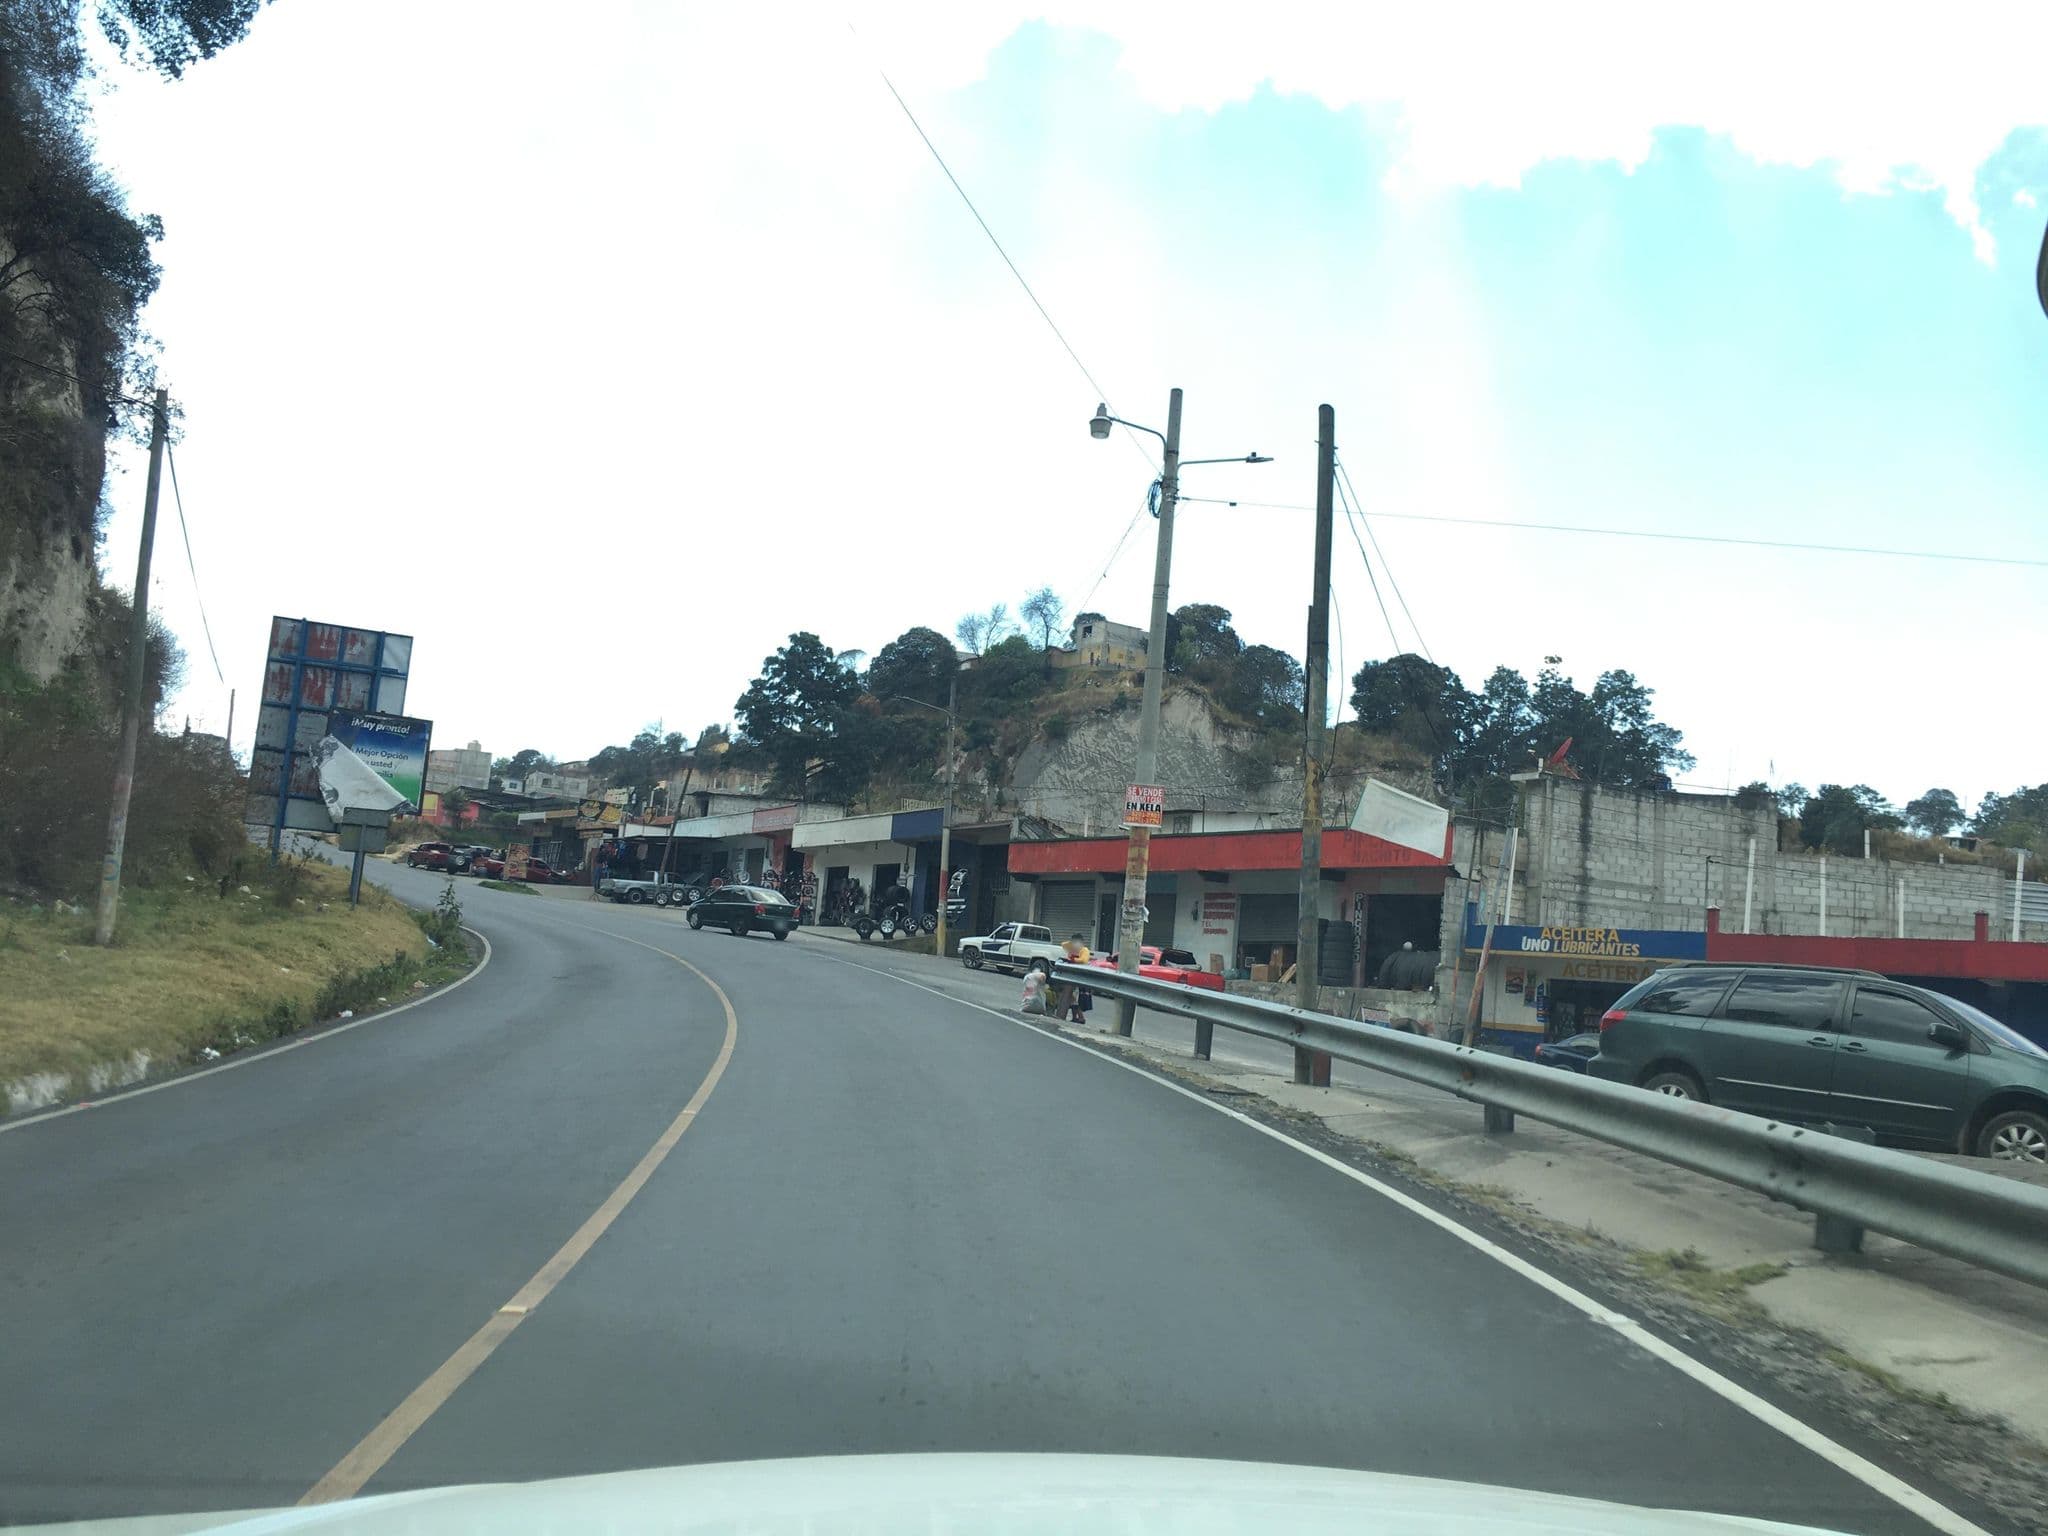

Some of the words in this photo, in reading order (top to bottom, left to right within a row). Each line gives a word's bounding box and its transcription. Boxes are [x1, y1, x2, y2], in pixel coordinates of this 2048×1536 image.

[375, 724, 410, 734] pronto!
[355, 747, 379, 756] Mejor
[380, 750, 409, 760] Opción
[370, 760, 392, 768] usted
[1126, 786, 1137, 796] SE
[1138, 787, 1164, 797] VENDE
[1126, 801, 1138, 811] EN
[1139, 803, 1161, 813] XELA
[1541, 927, 1620, 942] ACEITERA
[1521, 936, 1550, 952] UNO
[1553, 940, 1640, 956] LUBRICANTES
[1563, 963, 1650, 981] ACEITERA
